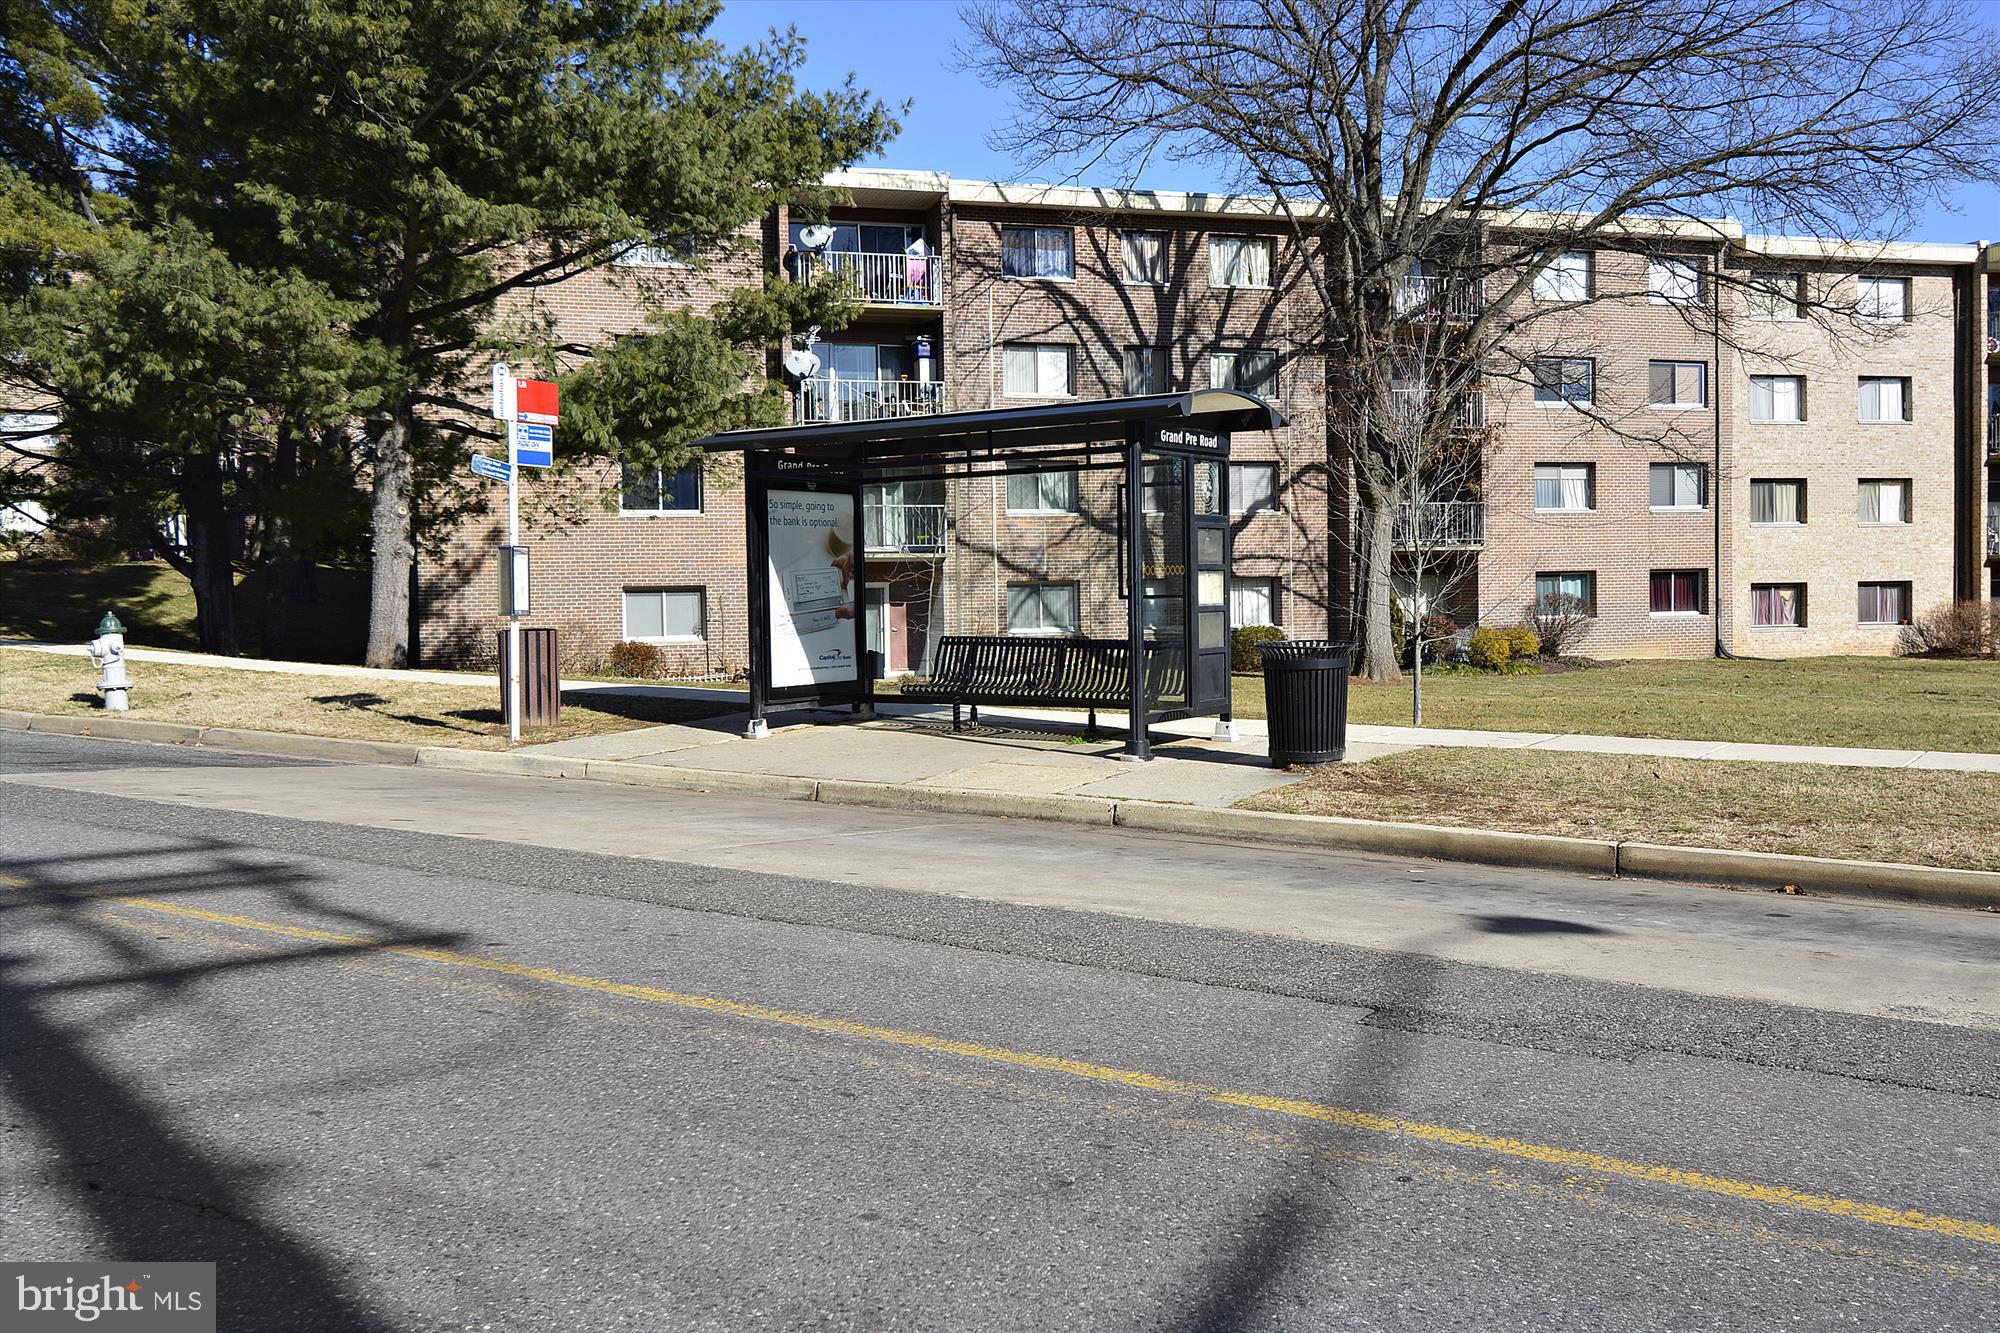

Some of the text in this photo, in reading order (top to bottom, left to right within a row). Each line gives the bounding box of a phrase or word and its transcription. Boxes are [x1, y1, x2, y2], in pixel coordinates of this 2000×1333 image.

[1160, 429, 1218, 449] Grand Pre Road
[777, 459, 804, 470] Grand
[769, 499, 835, 513] So simple, going to
[769, 516, 840, 529] the bank is optional.
